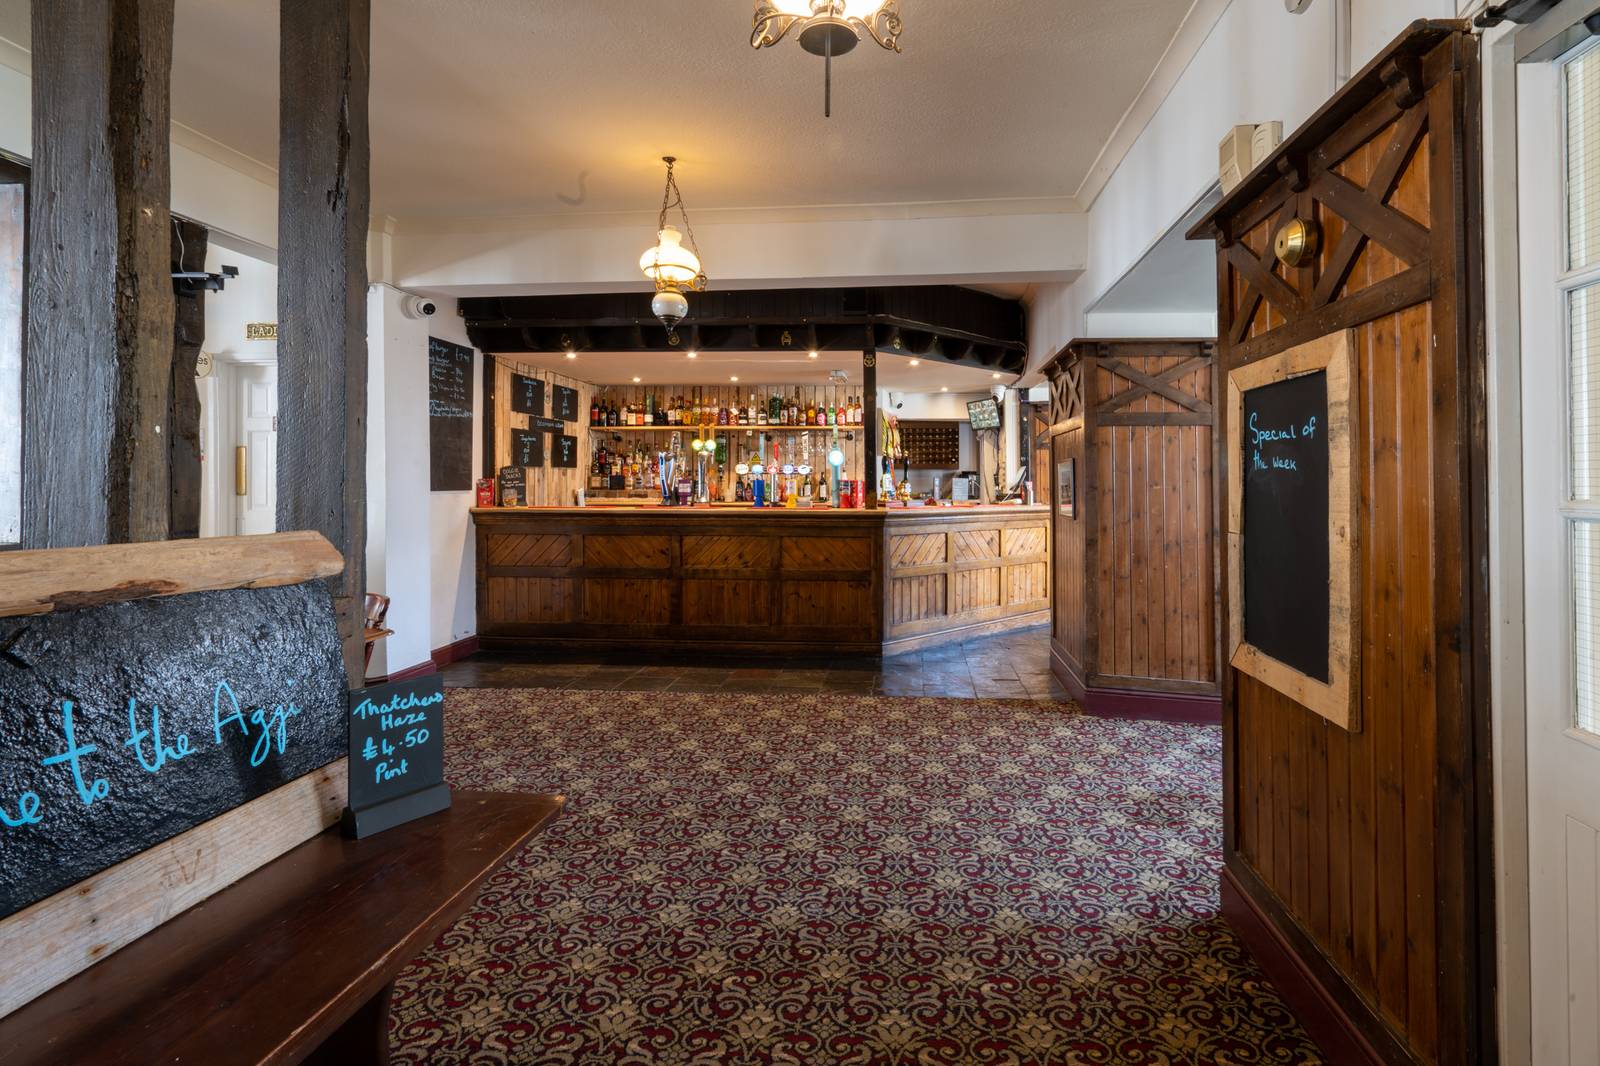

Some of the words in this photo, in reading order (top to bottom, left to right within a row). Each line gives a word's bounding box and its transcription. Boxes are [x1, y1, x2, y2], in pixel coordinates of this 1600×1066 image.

[1249, 412, 1297, 450] Special
[1302, 416, 1316, 439] of
[1253, 449, 1269, 471] the
[381, 712, 427, 731] Haze
[42, 700, 110, 805] to
[125, 697, 197, 772] the
[375, 759, 408, 784] Pint
